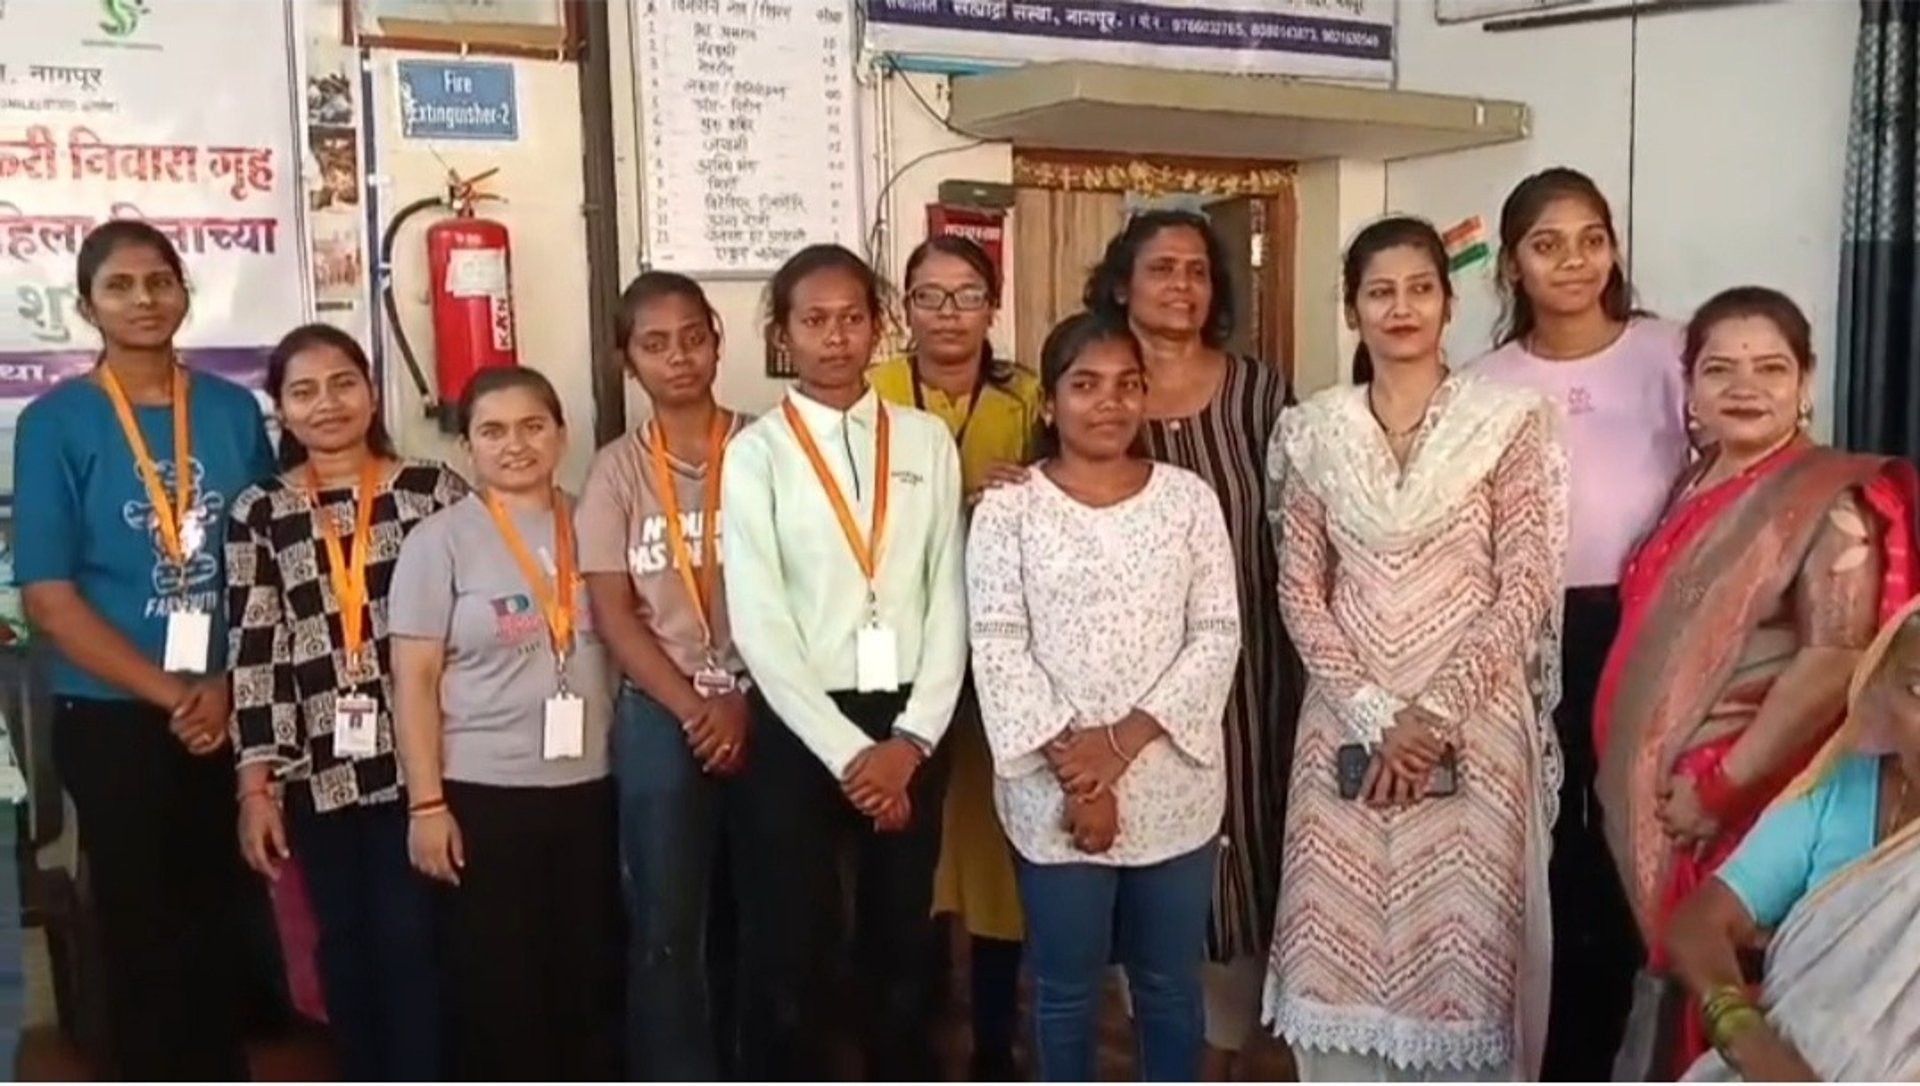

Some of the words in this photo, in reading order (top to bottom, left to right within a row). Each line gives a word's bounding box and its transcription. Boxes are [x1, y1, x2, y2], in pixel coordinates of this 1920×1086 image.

[29, 65, 103, 92] नागपूर
[443, 69, 473, 93] Fire
[208, 146, 273, 200] गृह
